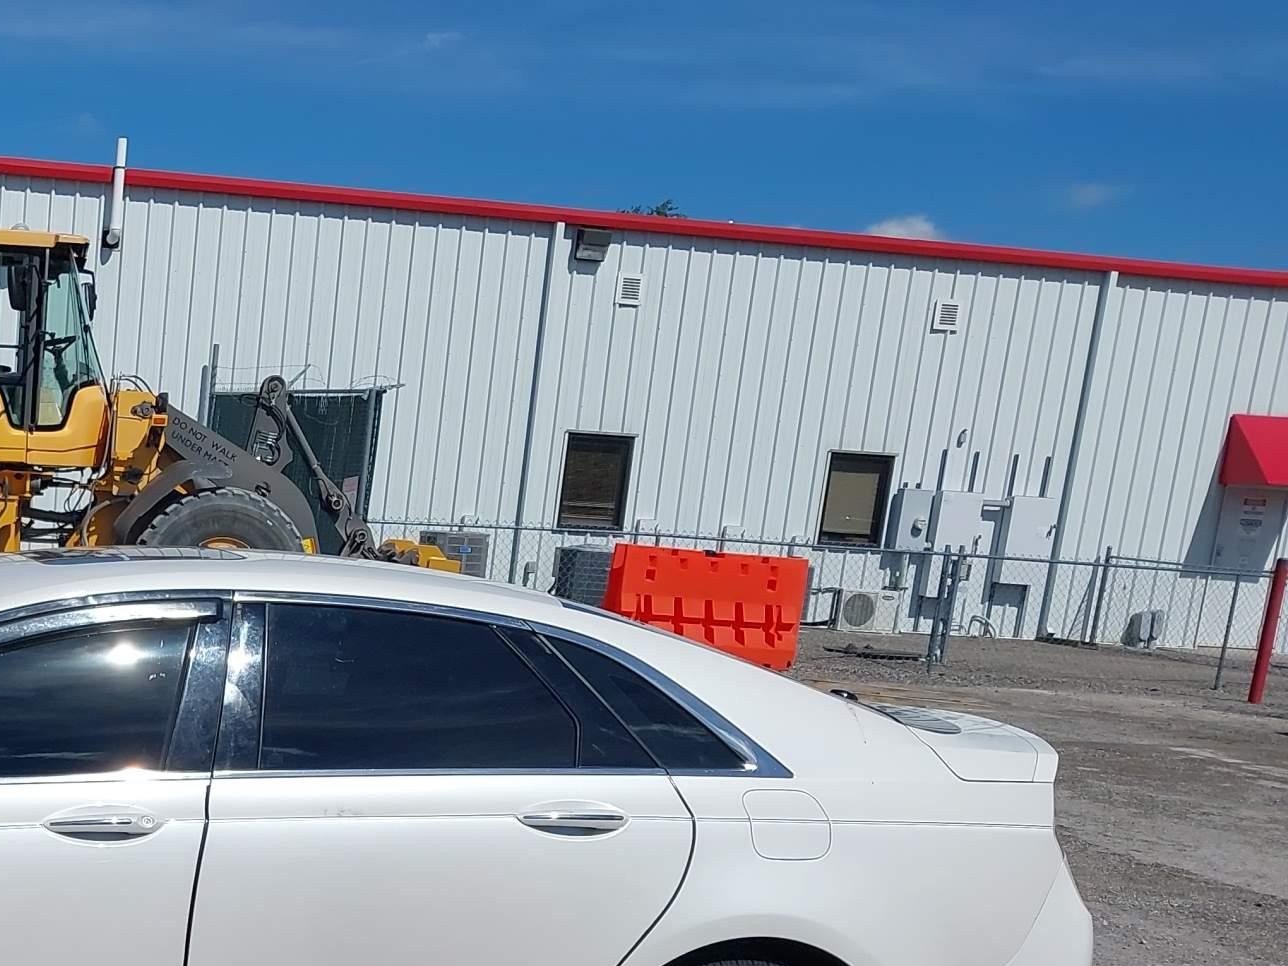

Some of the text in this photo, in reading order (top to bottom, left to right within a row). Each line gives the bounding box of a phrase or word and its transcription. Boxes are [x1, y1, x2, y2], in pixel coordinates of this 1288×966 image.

[171, 431, 203, 455] UNDER
[172, 416, 238, 462] DO NOT WALK
